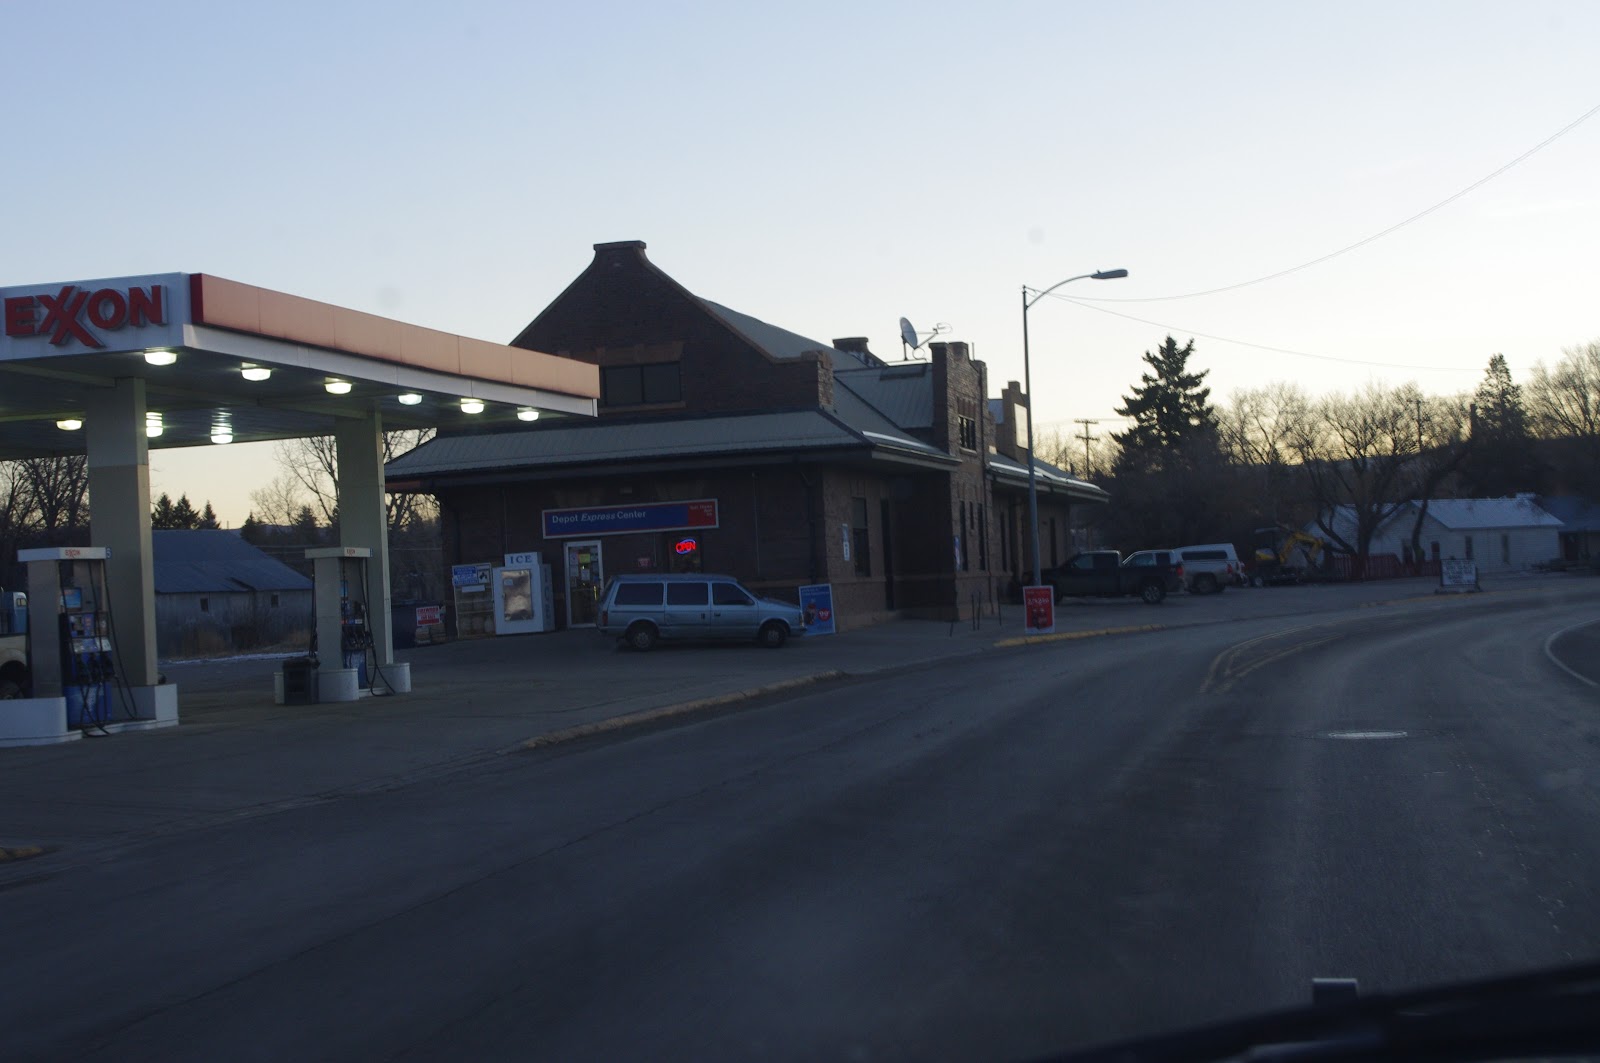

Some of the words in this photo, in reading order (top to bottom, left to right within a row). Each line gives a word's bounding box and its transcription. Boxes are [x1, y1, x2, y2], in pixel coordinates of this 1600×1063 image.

[4, 285, 165, 348] EXXON
[552, 514, 578, 524] Depot
[580, 512, 616, 522] Express
[616, 510, 646, 519] Center
[675, 541, 696, 552] OPEN
[510, 554, 533, 564] ICE
